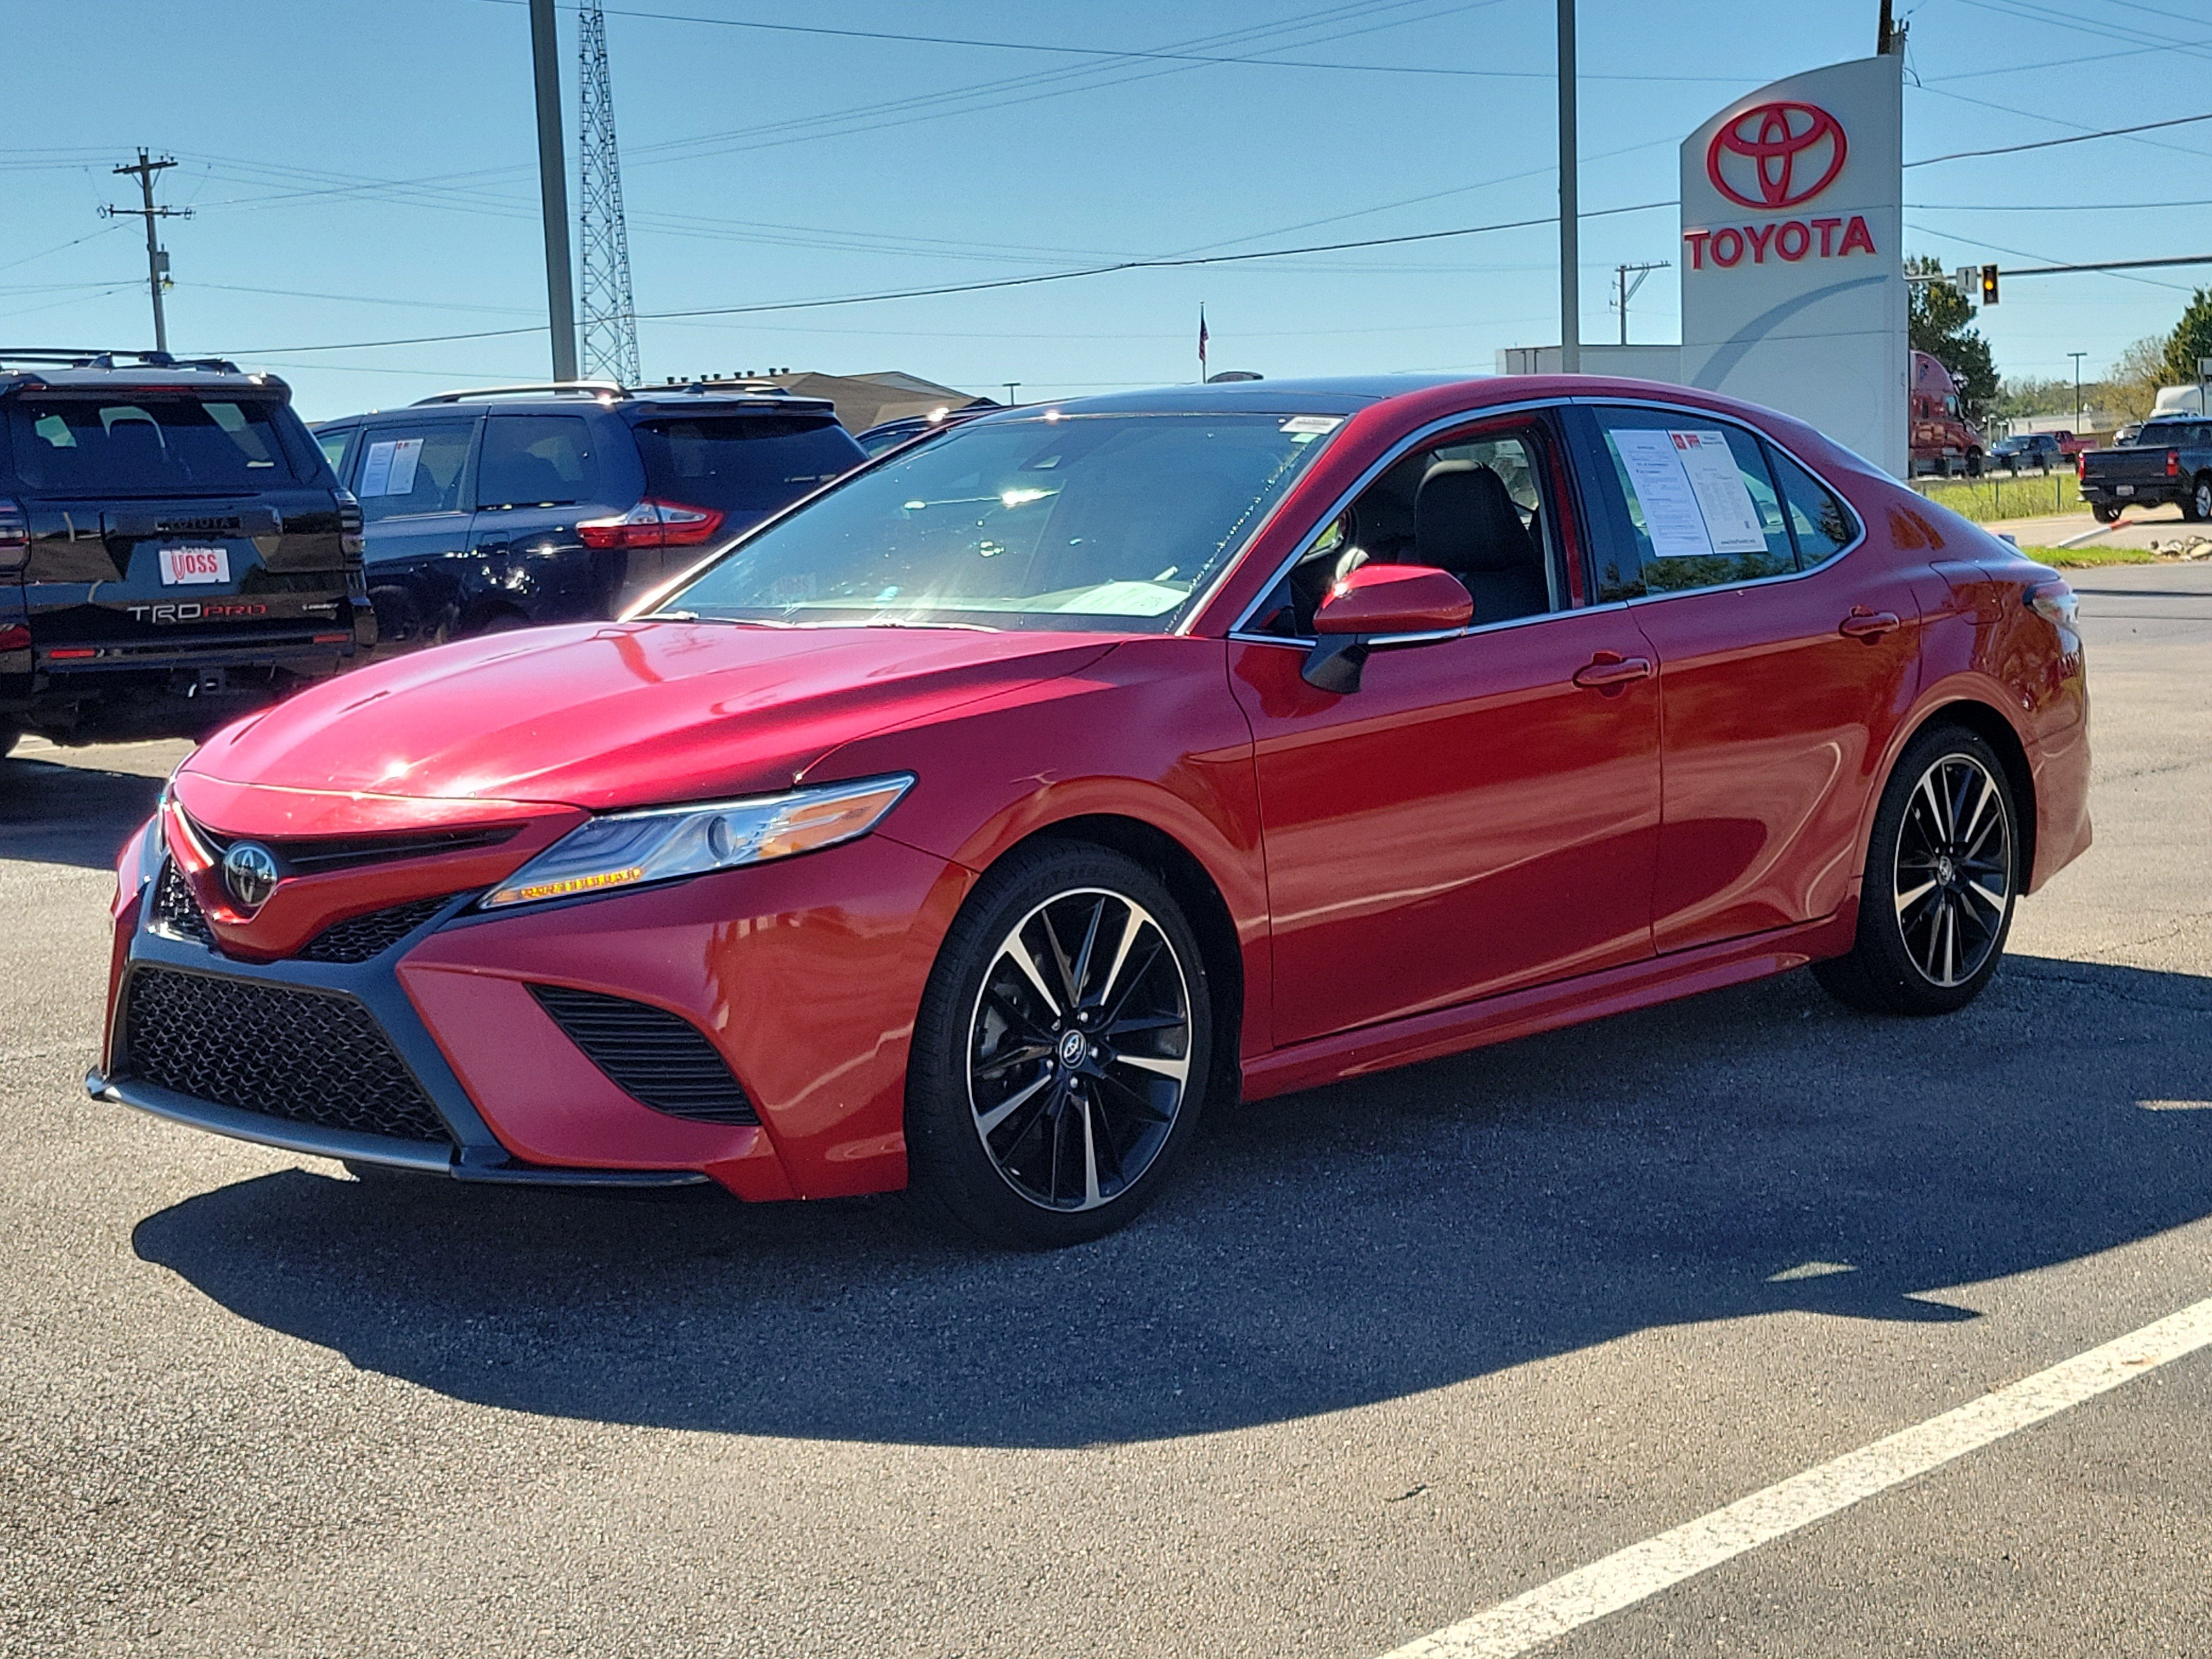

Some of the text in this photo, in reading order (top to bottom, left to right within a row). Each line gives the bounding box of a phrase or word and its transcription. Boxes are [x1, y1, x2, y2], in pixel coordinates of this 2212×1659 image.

[1683, 216, 1876, 270] TOYOTA
[171, 554, 218, 580] VOSS
[127, 604, 267, 624] TRD PRO
